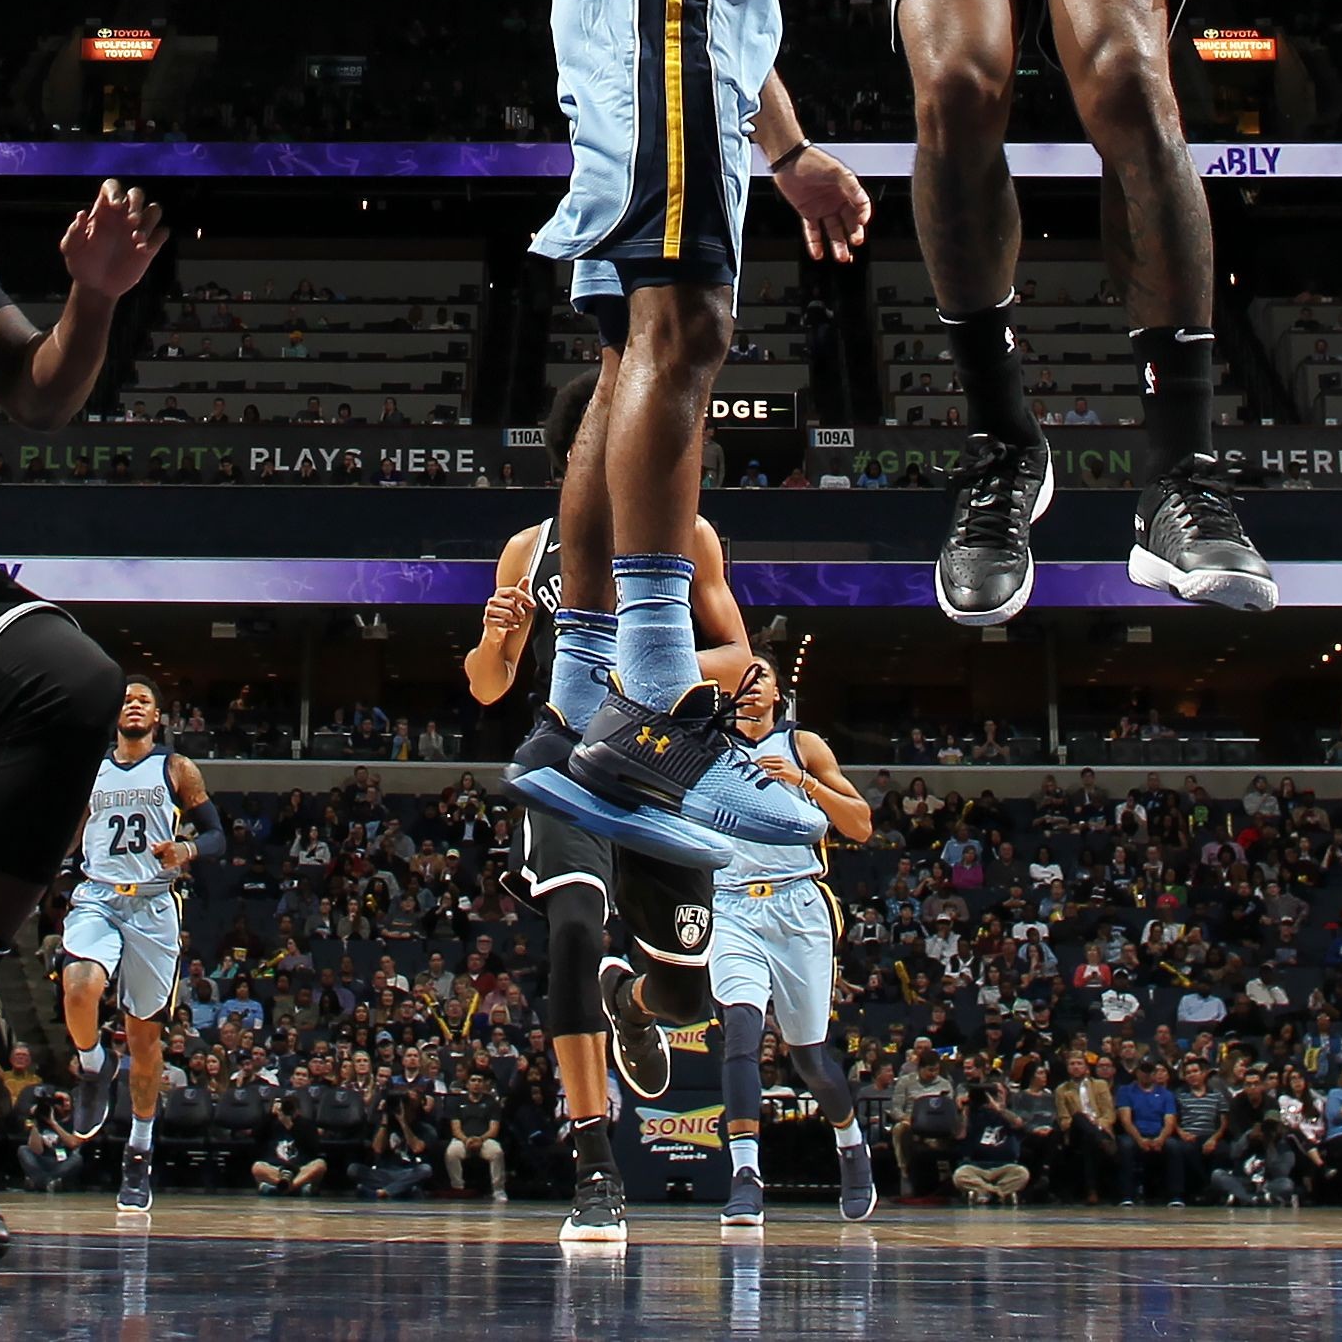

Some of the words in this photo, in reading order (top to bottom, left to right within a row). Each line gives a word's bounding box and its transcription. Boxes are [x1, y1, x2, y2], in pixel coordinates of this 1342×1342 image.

[113, 29, 151, 37] TOYOTA
[1219, 30, 1259, 38] TOYOTA
[94, 40, 154, 50] WOLFCHASE
[1229, 41, 1271, 50] HUTTON
[104, 49, 143, 58] TOYOTA
[1213, 50, 1252, 58] TOYOTA
[510, 431, 543, 444] 110A
[817, 431, 851, 445] 109A
[90, 784, 165, 808] MEMPHIS
[108, 813, 148, 857] 23
[676, 908, 710, 927] NETS
[644, 1115, 721, 1136] SONIC
[650, 1143, 696, 1153] America's
